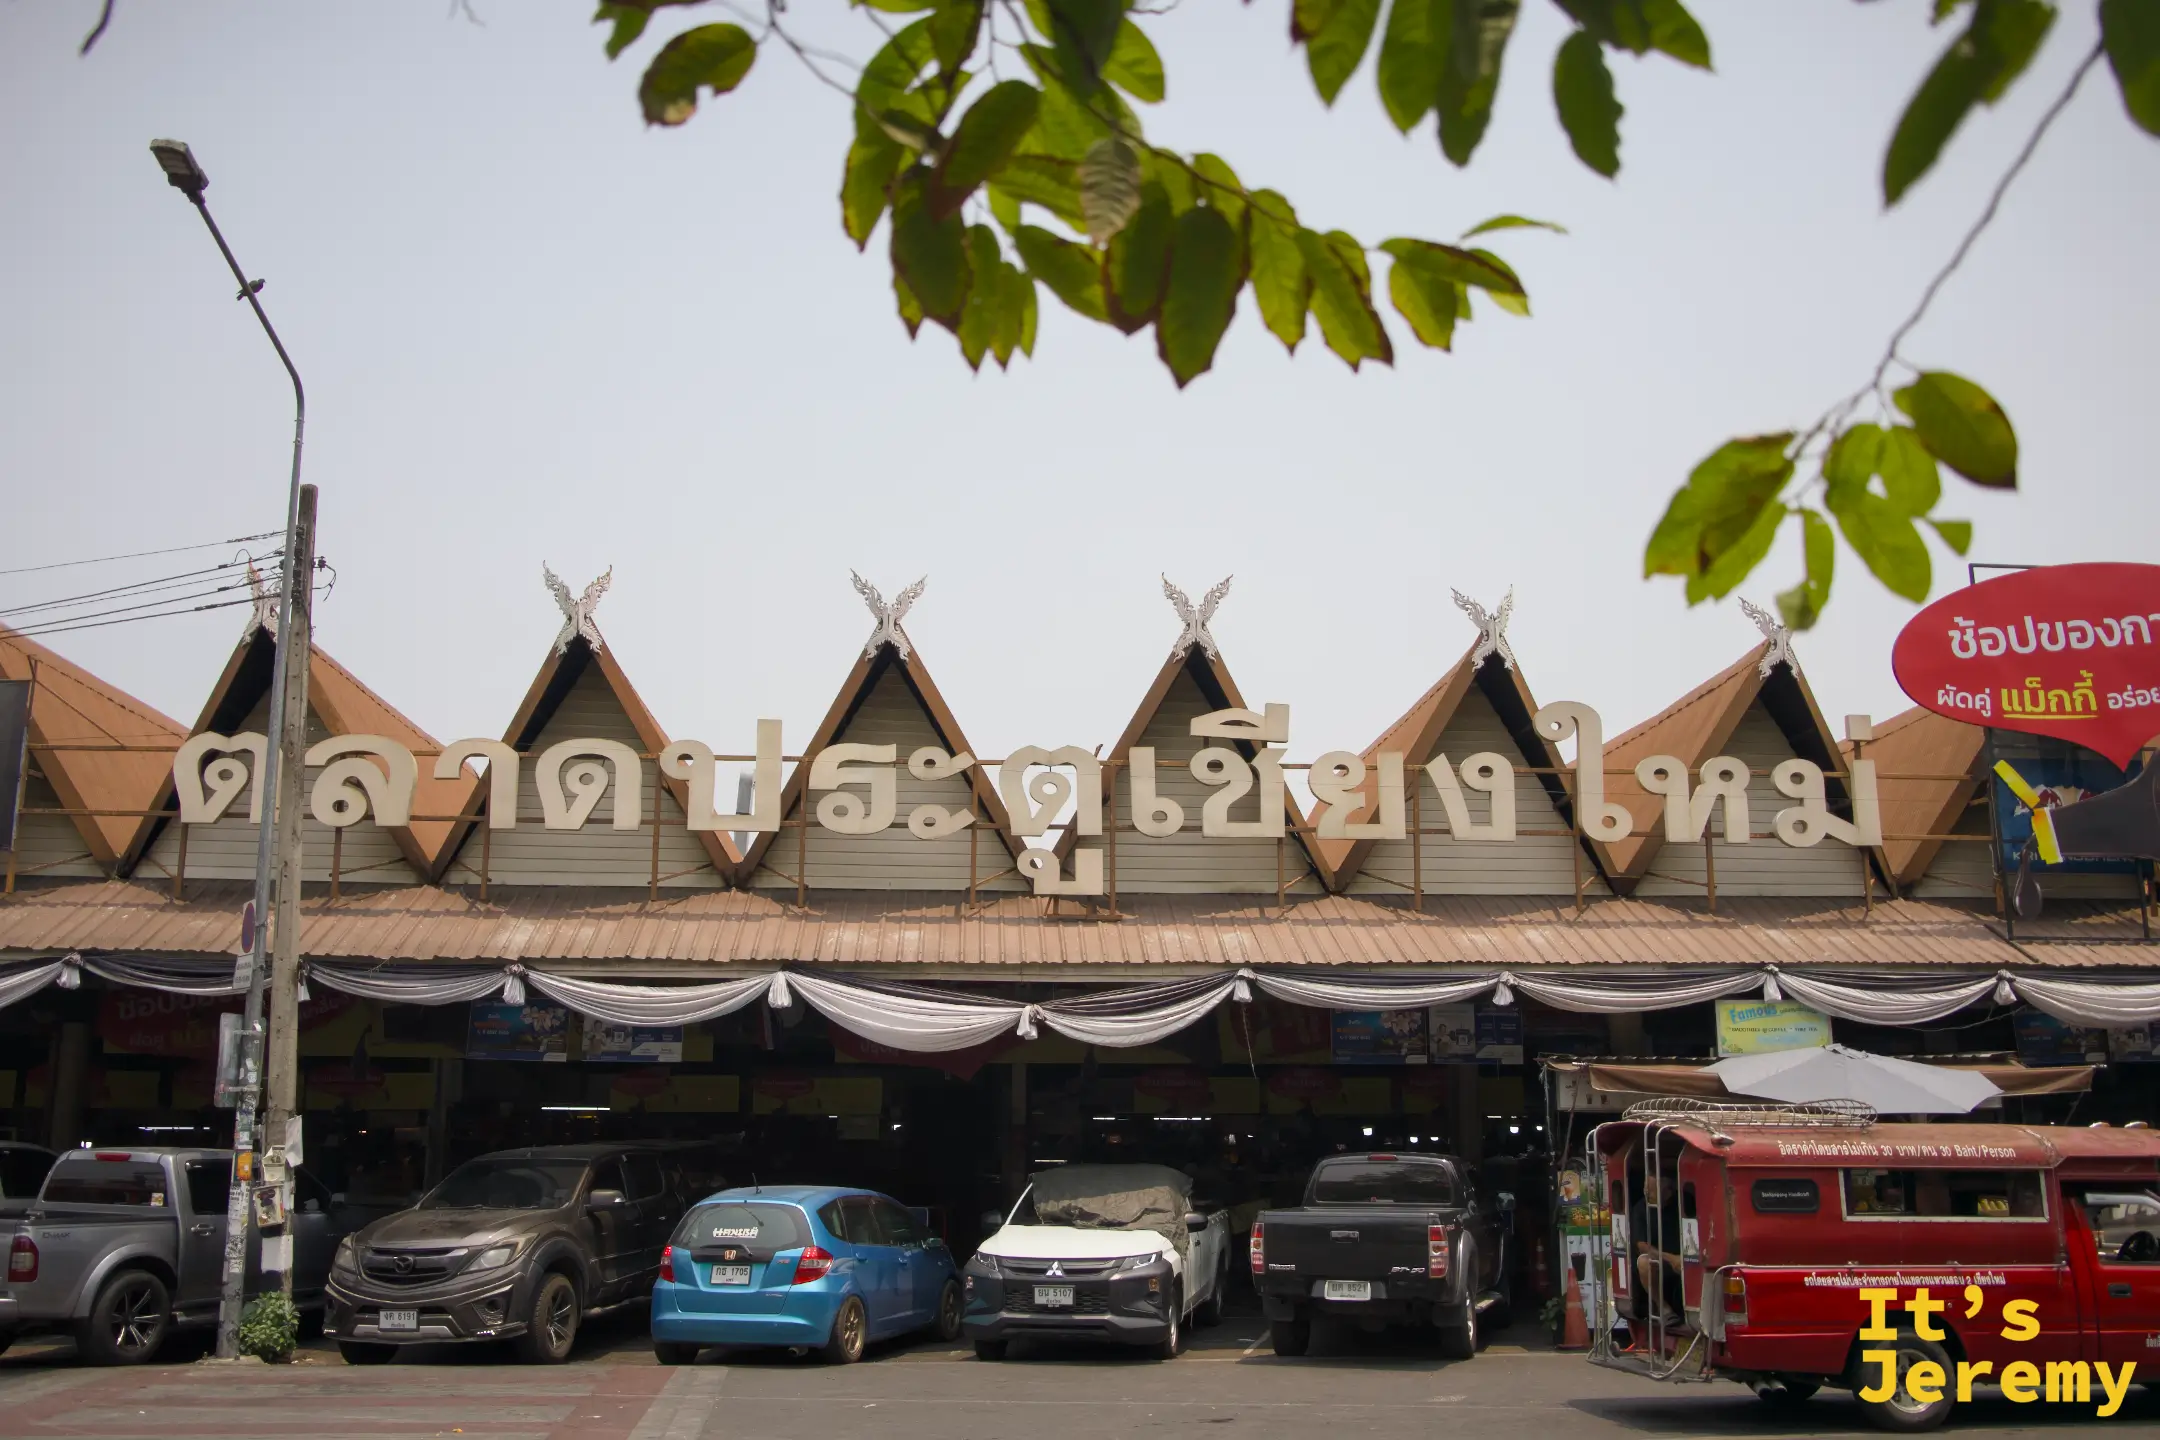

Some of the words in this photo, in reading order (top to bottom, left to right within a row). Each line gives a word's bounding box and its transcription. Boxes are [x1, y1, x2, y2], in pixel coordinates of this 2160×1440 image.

[1937, 684, 1992, 717] ผัดคู่
[2001, 669, 2098, 713] แม็กกี้
[172, 700, 1883, 897] ตลาดประตูเชียงใหม่
[1729, 1004, 1778, 1024] Famous
[1881, 1144, 1893, 1156] 30
[1940, 1144, 1952, 1157] 30
[1954, 1144, 2016, 1158] Baht/Person
[731, 1267, 748, 1276] 1705
[1052, 1288, 1072, 1297] 5107
[397, 1312, 415, 1321] 6191
